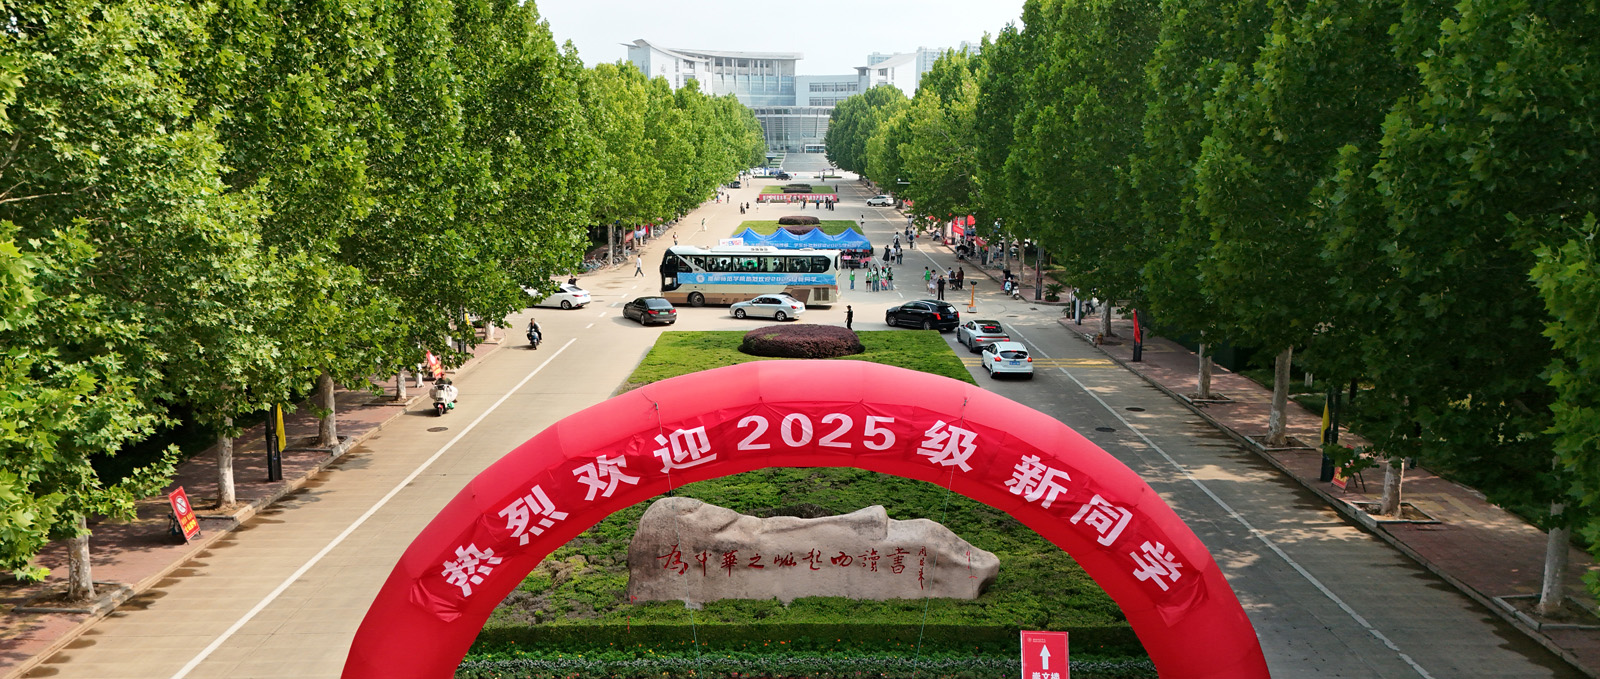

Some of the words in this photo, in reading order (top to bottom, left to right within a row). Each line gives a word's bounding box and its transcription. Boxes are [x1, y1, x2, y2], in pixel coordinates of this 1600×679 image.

[441, 412, 1182, 597] 热烈欢迎2025级新同学
